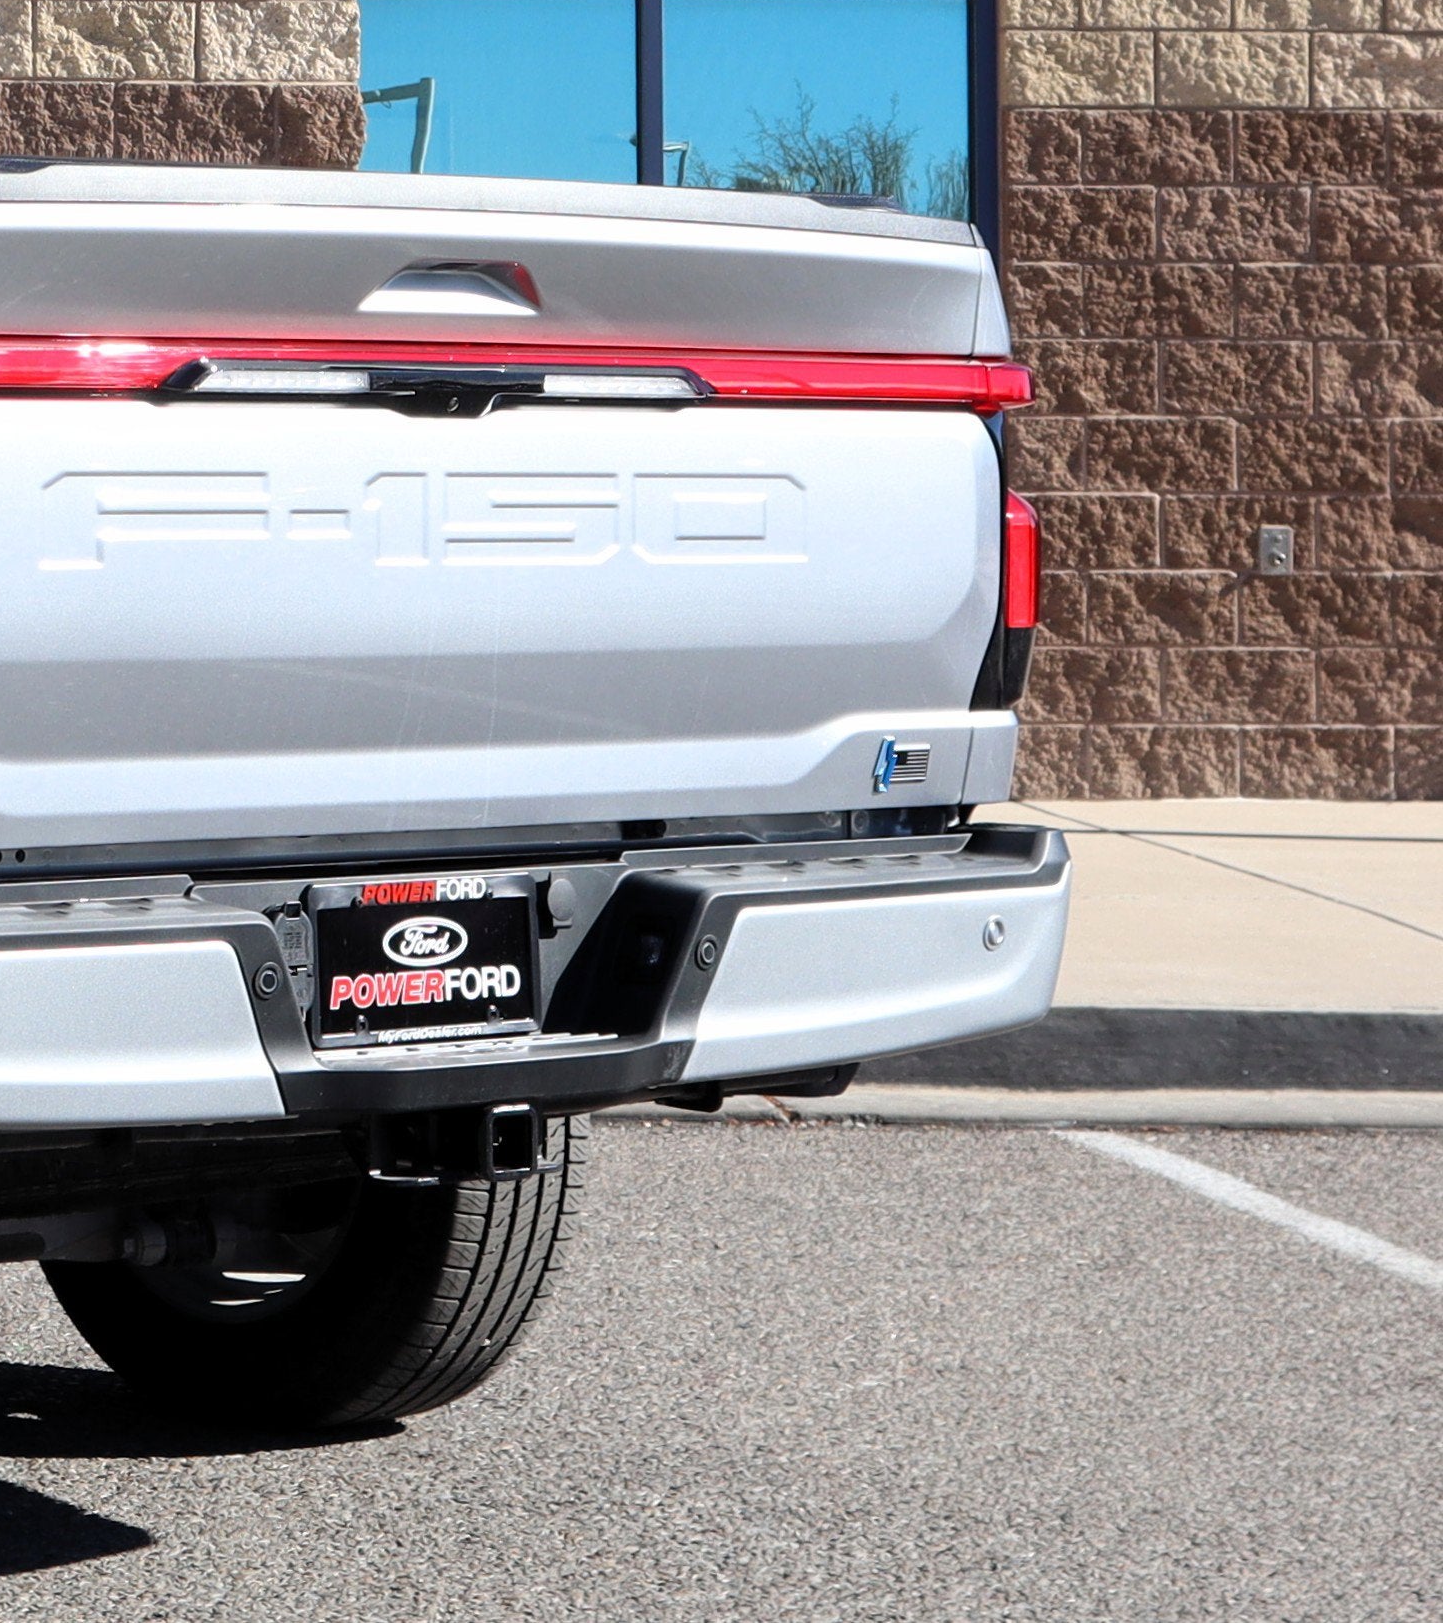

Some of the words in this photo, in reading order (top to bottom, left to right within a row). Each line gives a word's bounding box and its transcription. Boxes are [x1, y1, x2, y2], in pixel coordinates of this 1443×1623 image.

[38, 470, 809, 572] F-150
[400, 926, 451, 955] Ford
[378, 1025, 482, 1044] MyFordDealer.com
